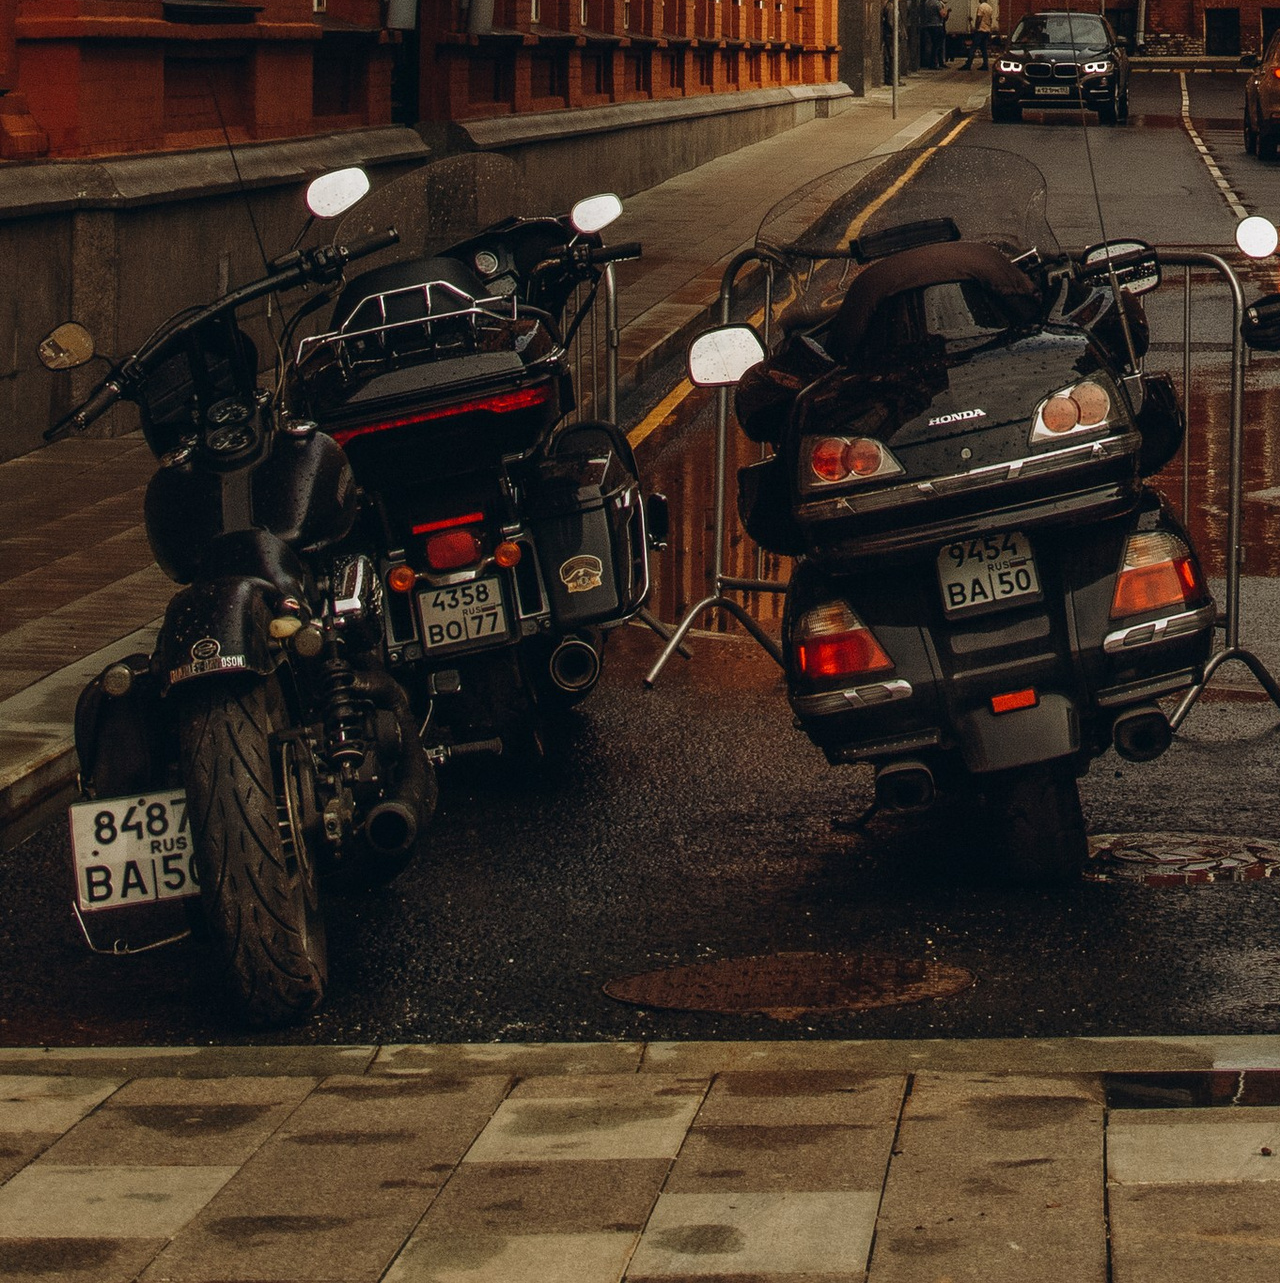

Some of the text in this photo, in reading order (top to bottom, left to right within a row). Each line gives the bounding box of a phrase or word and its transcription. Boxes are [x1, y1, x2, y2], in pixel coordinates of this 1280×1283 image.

[928, 408, 987, 426] HONDA
[948, 533, 1018, 568] 9454
[987, 561, 1010, 572] RUS
[432, 583, 489, 611] 4358
[948, 568, 1031, 606] ВА 50
[462, 606, 481, 616] RUS
[428, 612, 498, 644] ВО 77
[94, 798, 187, 845] 8487
[151, 836, 188, 854] RUS
[86, 860, 149, 902] ВА
